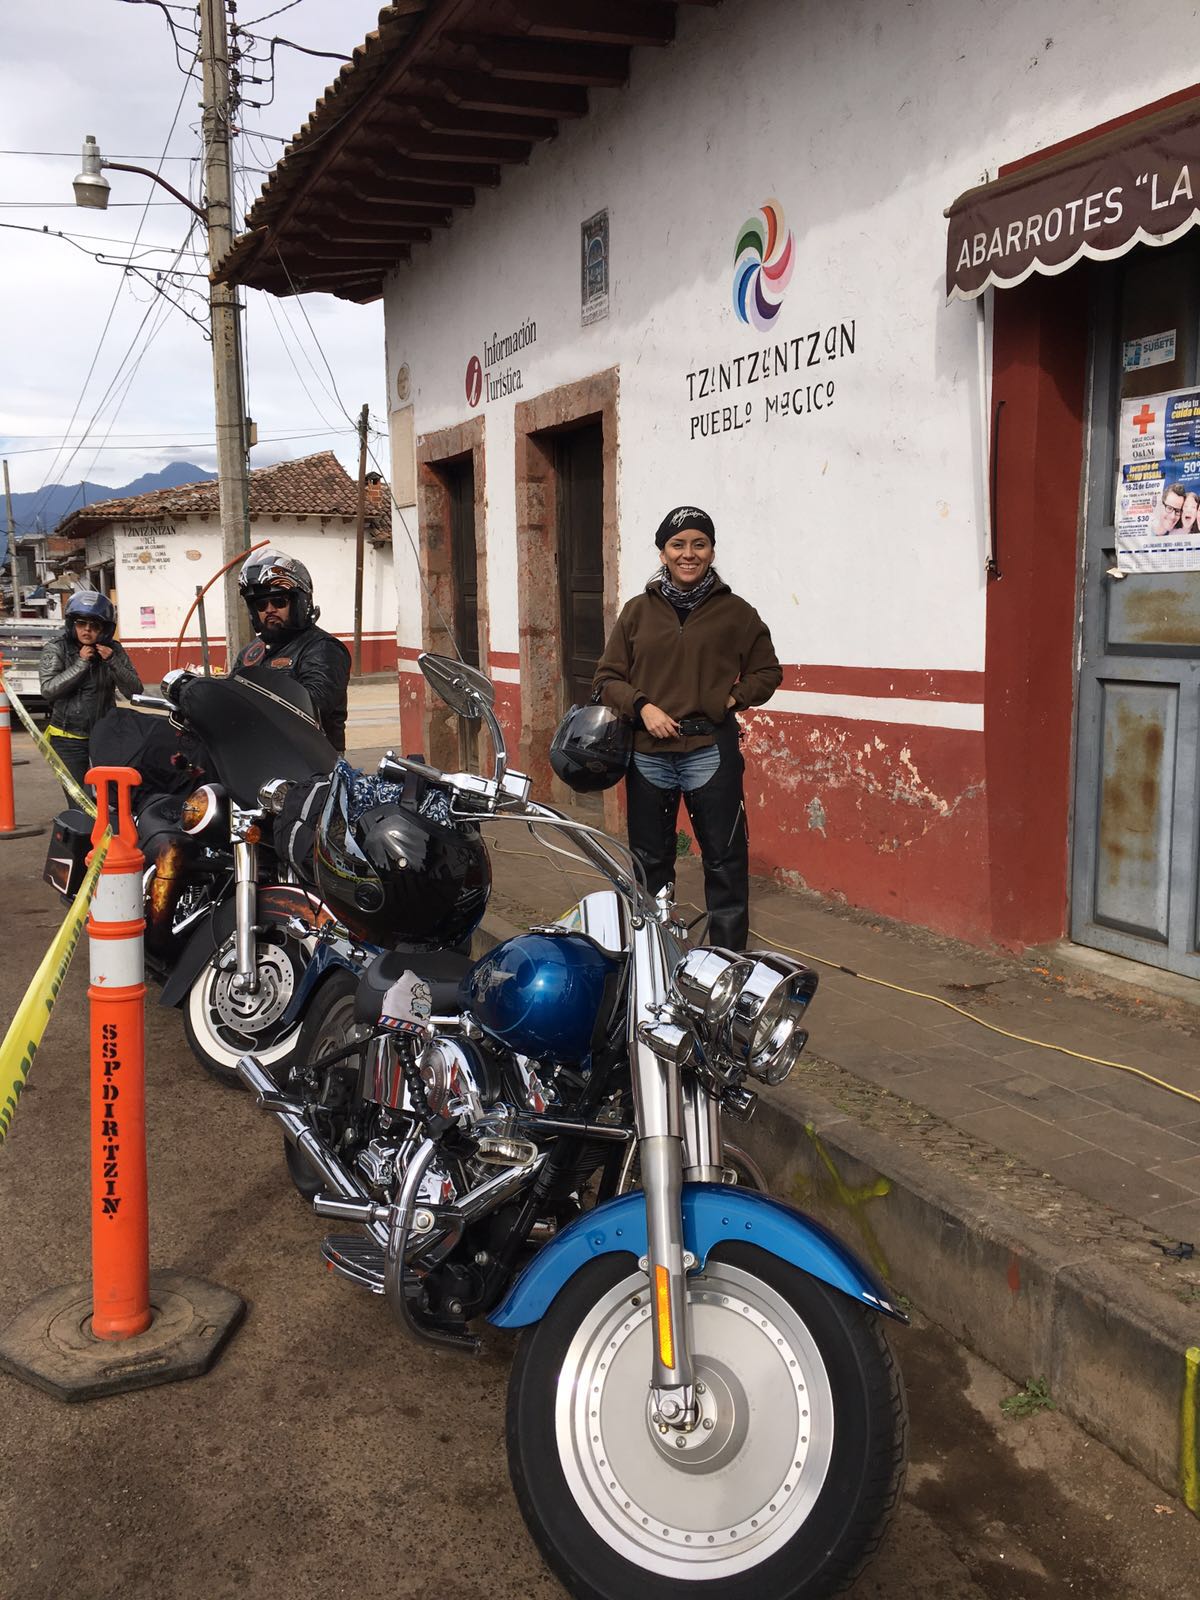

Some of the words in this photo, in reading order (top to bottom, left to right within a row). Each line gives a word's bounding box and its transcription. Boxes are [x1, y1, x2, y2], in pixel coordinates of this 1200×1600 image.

[956, 186, 1123, 272] ABARROTES
[483, 316, 537, 368] Información
[690, 401, 752, 440] PUEBLO
